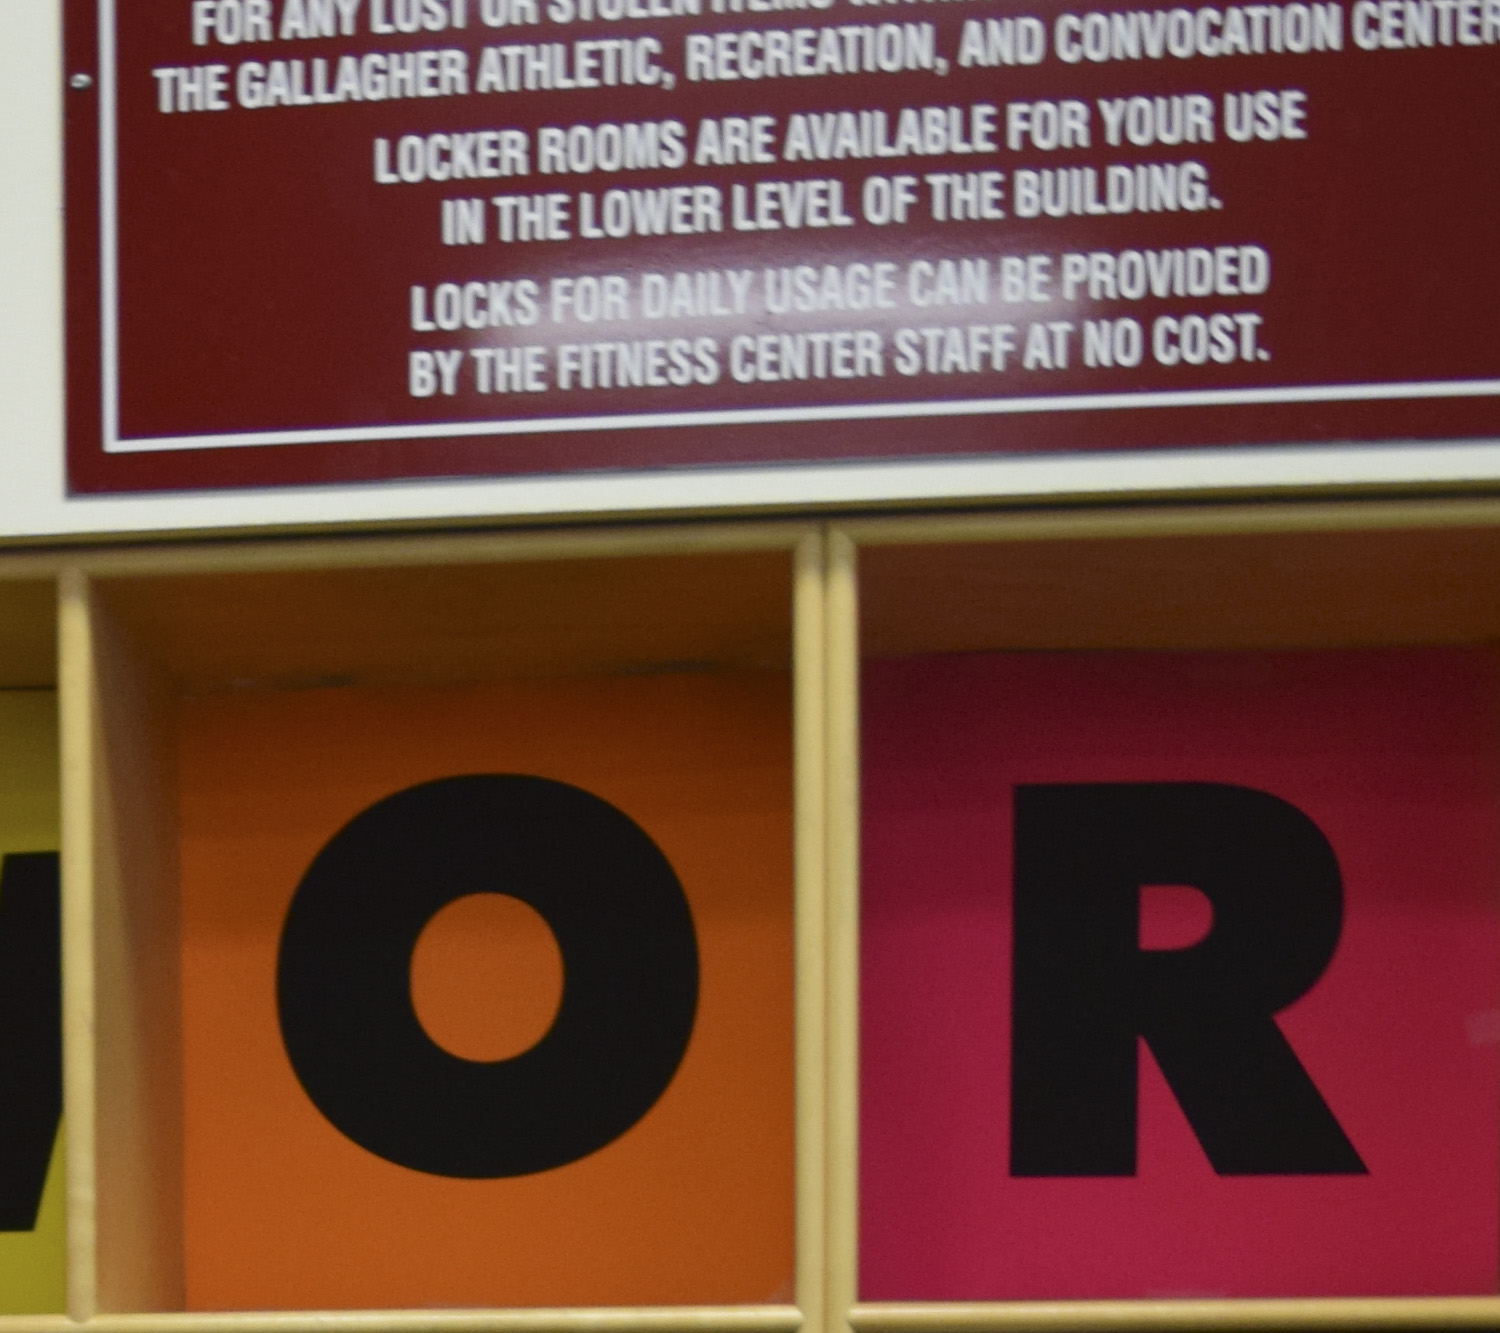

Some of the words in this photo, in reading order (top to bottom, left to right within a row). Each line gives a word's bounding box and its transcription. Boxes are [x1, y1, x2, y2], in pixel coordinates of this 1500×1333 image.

[153, 64, 229, 114] THE
[237, 48, 466, 109] GALLAGHER
[478, 36, 670, 94] ATHLETIC,
[687, 22, 944, 82] RECREATION,
[960, 16, 1043, 68] AND
[1056, 1, 1340, 64] CONVOCATION
[191, 0, 273, 45] FOR
[279, 0, 357, 40] ANY
[375, 128, 527, 185] LOCKER
[539, 119, 685, 174] ROOMS
[696, 115, 773, 166] ARE
[785, 103, 995, 162] AVAILABLE
[1008, 99, 1087, 151] FOR
[1101, 93, 1212, 147] YOUR
[1225, 89, 1304, 143] USE
[443, 197, 483, 246] IN
[499, 192, 568, 243] THE
[581, 184, 720, 239] LOWER
[734, 178, 849, 232] LEVEL
[864, 174, 915, 226] OF
[932, 170, 1002, 222] THE
[1015, 160, 1223, 218] BUILDING.
[410, 278, 542, 335] LOCKS
[549, 275, 628, 332] FOR
[642, 269, 749, 320] DAILY
[767, 262, 893, 314] USAGE
[909, 258, 989, 308] CAN
[1000, 254, 1051, 312] BE
[1060, 244, 1269, 308] PROVIDED
[410, 348, 460, 398] BY
[476, 338, 545, 394] THE
[558, 331, 717, 390] FITNESS
[732, 324, 881, 383] CENTER
[896, 318, 1012, 376] STAFF
[1025, 316, 1066, 370] AT
[1084, 316, 1141, 368] NO
[1153, 312, 1271, 366] COST.
